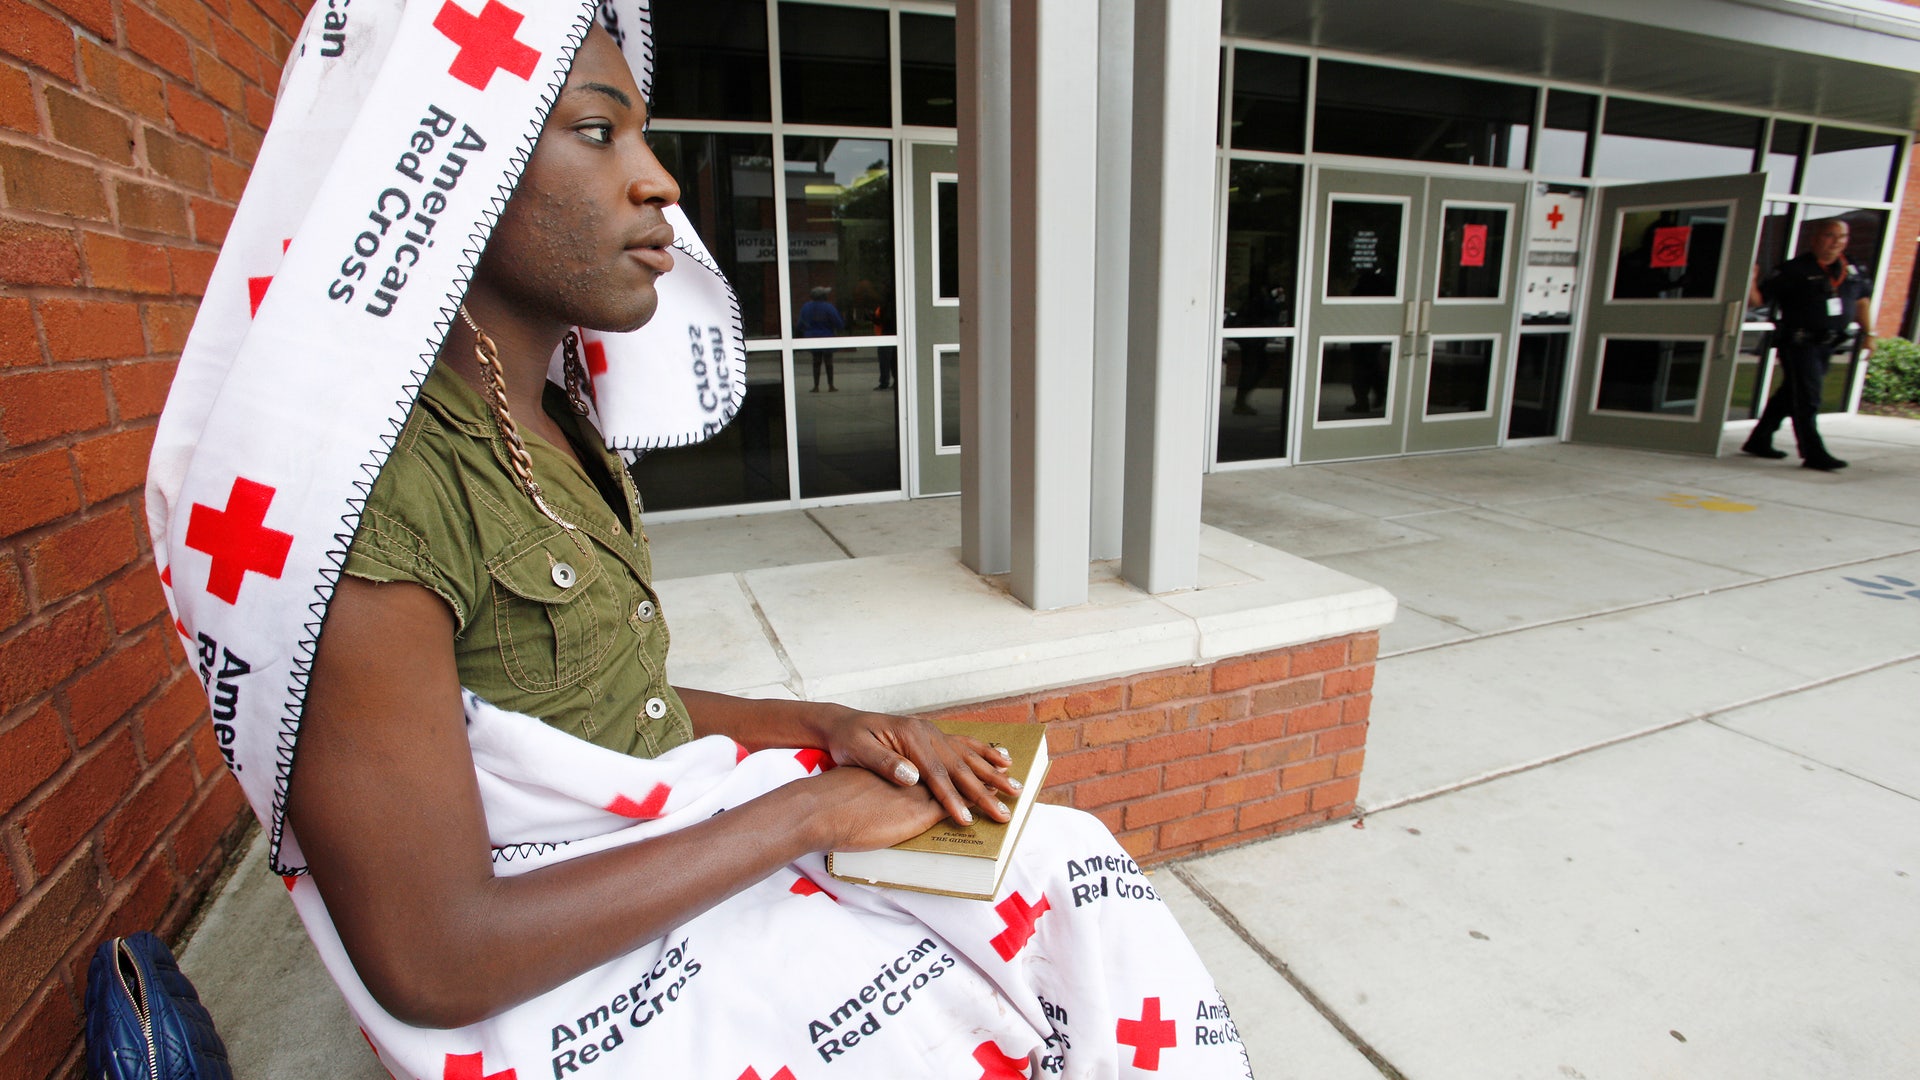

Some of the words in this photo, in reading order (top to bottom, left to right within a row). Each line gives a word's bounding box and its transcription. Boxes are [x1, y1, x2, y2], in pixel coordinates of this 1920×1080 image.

[395, 104, 457, 184] Red
[328, 187, 411, 304] Cross
[365, 123, 487, 318] American
[213, 646, 251, 783] Ameri
[1066, 853, 1144, 882] Americ
[808, 938, 938, 1044] American
[817, 1012, 882, 1064] Red
[882, 953, 956, 1016] Cross
[551, 1023, 625, 1080] Red
